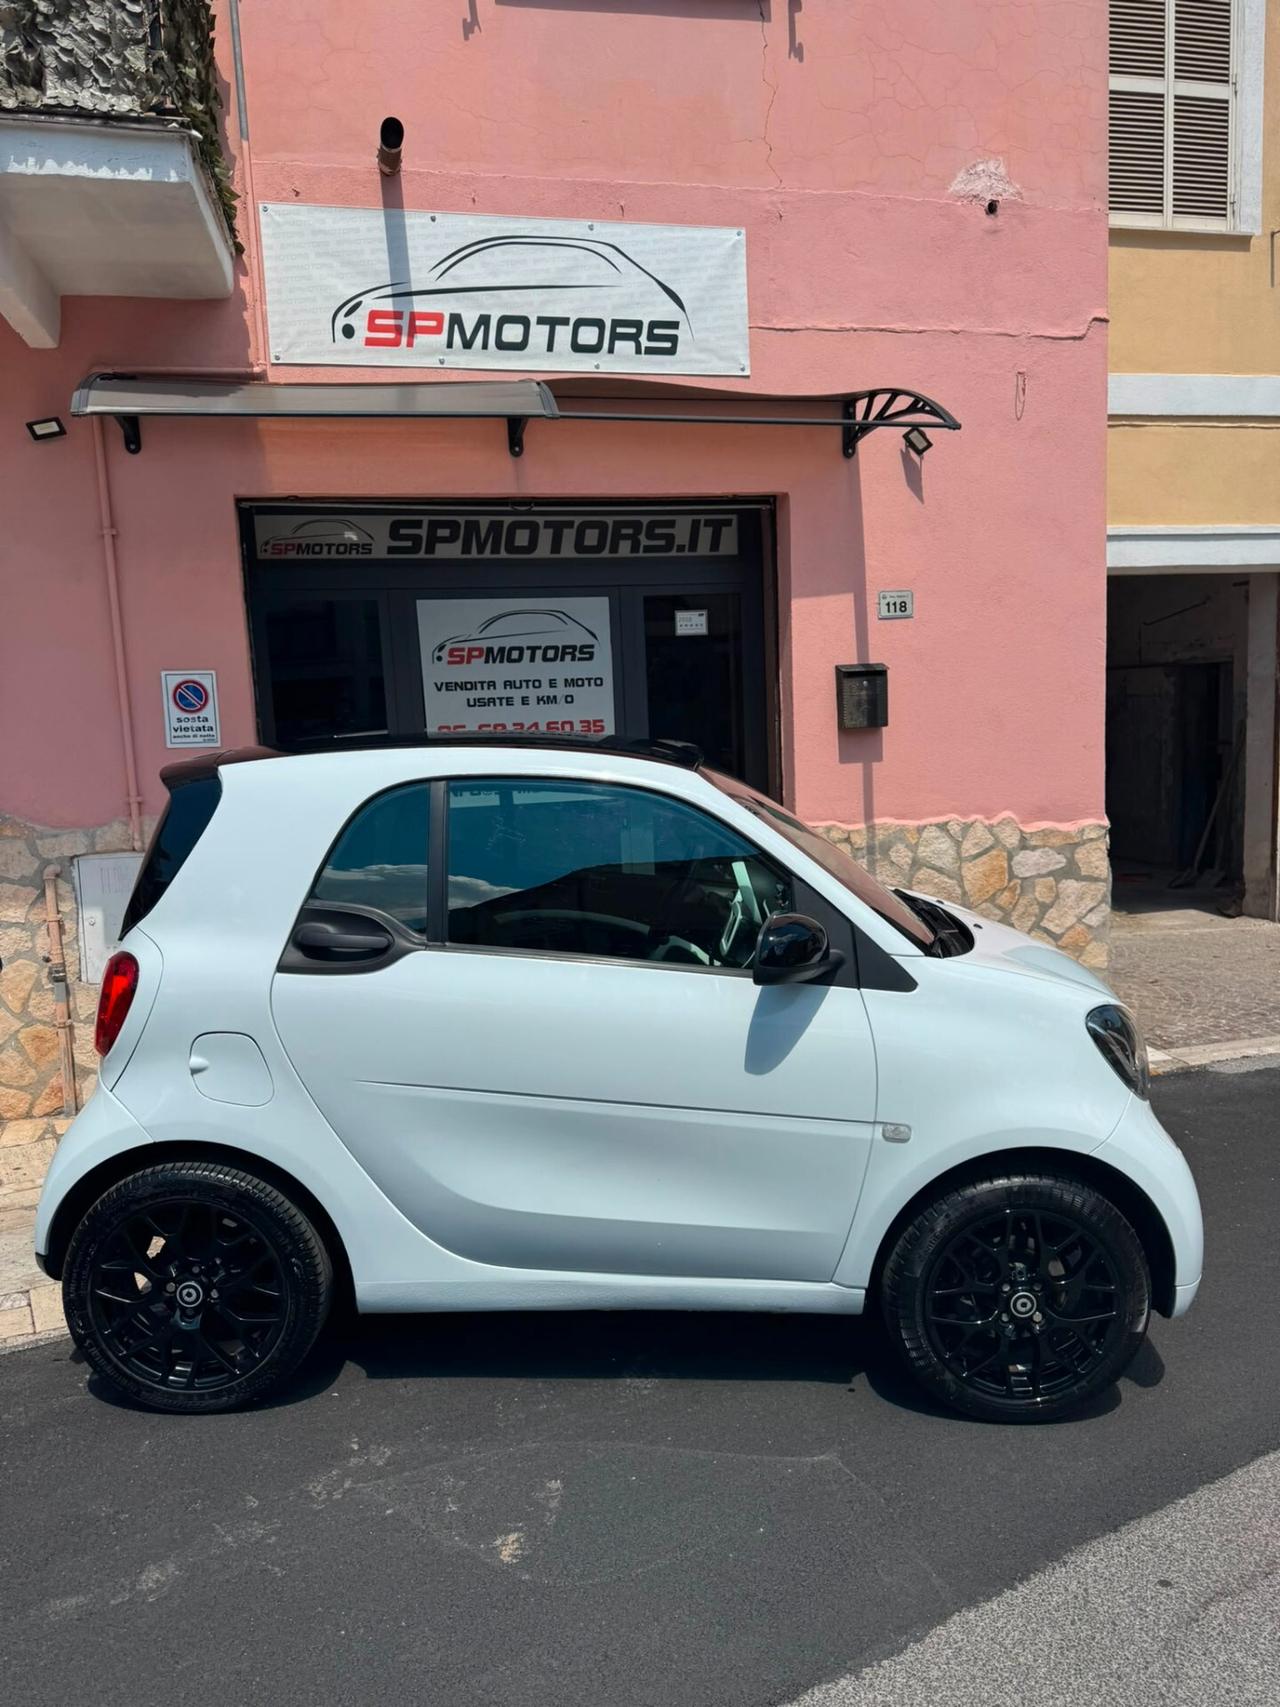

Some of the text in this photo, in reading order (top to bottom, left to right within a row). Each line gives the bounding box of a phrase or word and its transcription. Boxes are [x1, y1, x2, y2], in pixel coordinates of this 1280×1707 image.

[364, 309, 680, 356] SPMOTORS
[387, 518, 733, 555] SPMOTORS.IT
[269, 543, 374, 555] SPMOTORS
[886, 601, 907, 613] 118
[447, 644, 595, 665] SPMOTORS
[433, 677, 604, 692] VENDITA AUTO E MOTO
[466, 696, 515, 707] USATE
[521, 695, 530, 706] E
[176, 715, 209, 723] sosta
[173, 725, 214, 733] vietata
